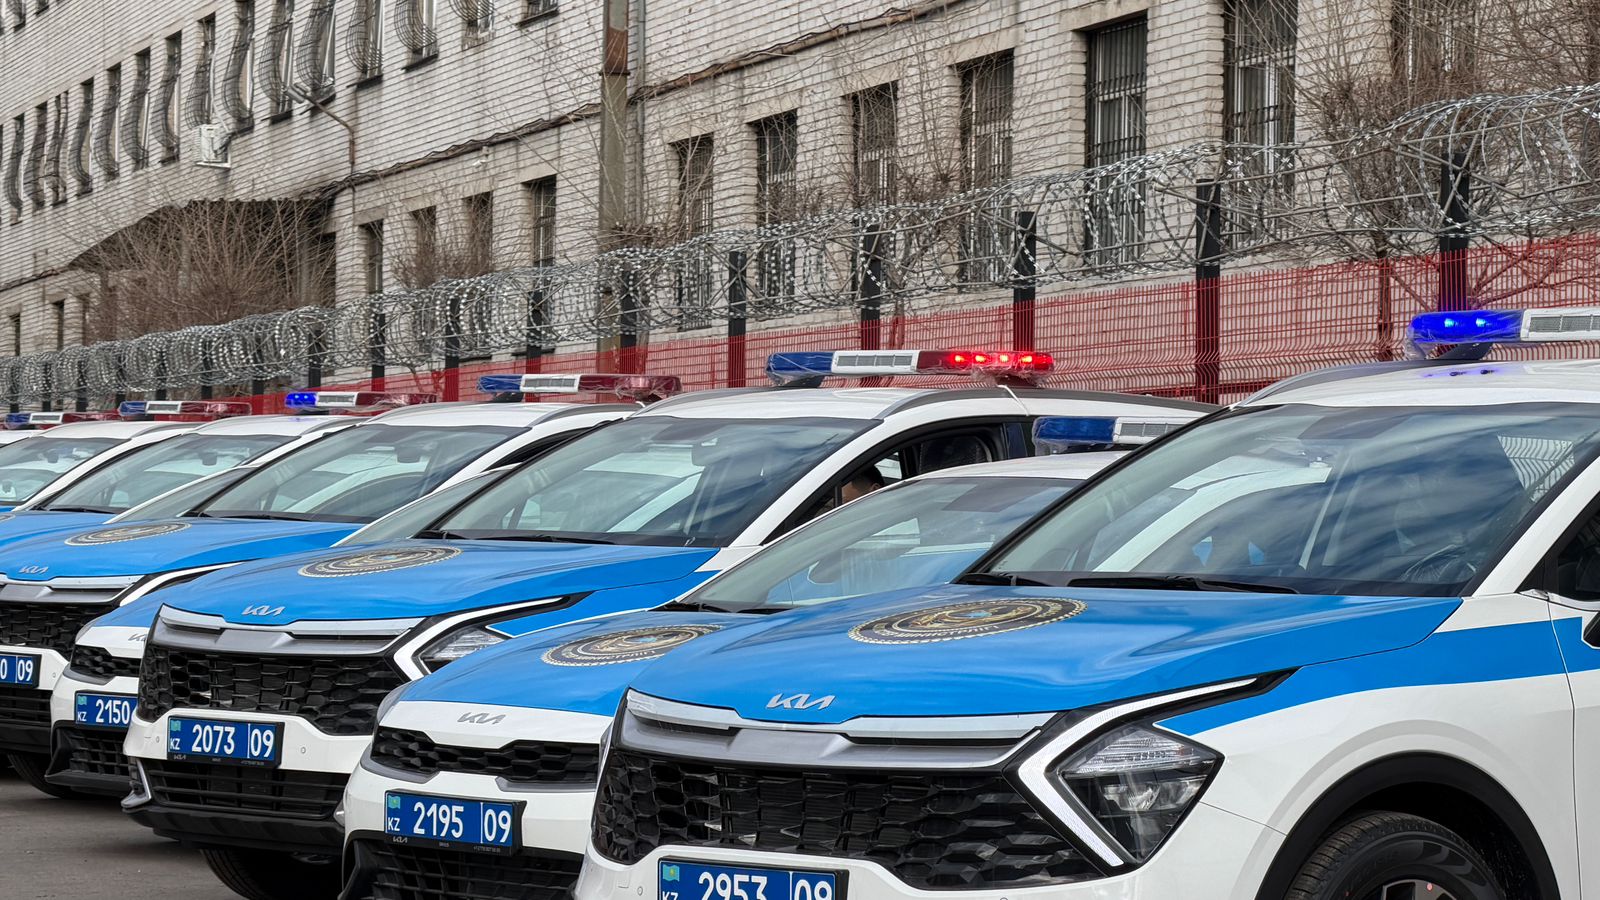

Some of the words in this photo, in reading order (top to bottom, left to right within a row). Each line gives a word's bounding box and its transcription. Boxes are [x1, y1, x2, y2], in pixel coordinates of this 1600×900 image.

[241, 604, 286, 617] KIA
[17, 659, 34, 682] 09
[77, 711, 87, 722] KZ
[95, 698, 131, 725] 2150
[765, 693, 836, 710] KIA
[457, 711, 506, 724] KIA
[169, 737, 180, 750] KZ
[191, 724, 236, 755] 2073
[250, 728, 275, 758] 09
[387, 816, 401, 832] KZ
[412, 801, 465, 838] 2195
[483, 808, 512, 843] 09
